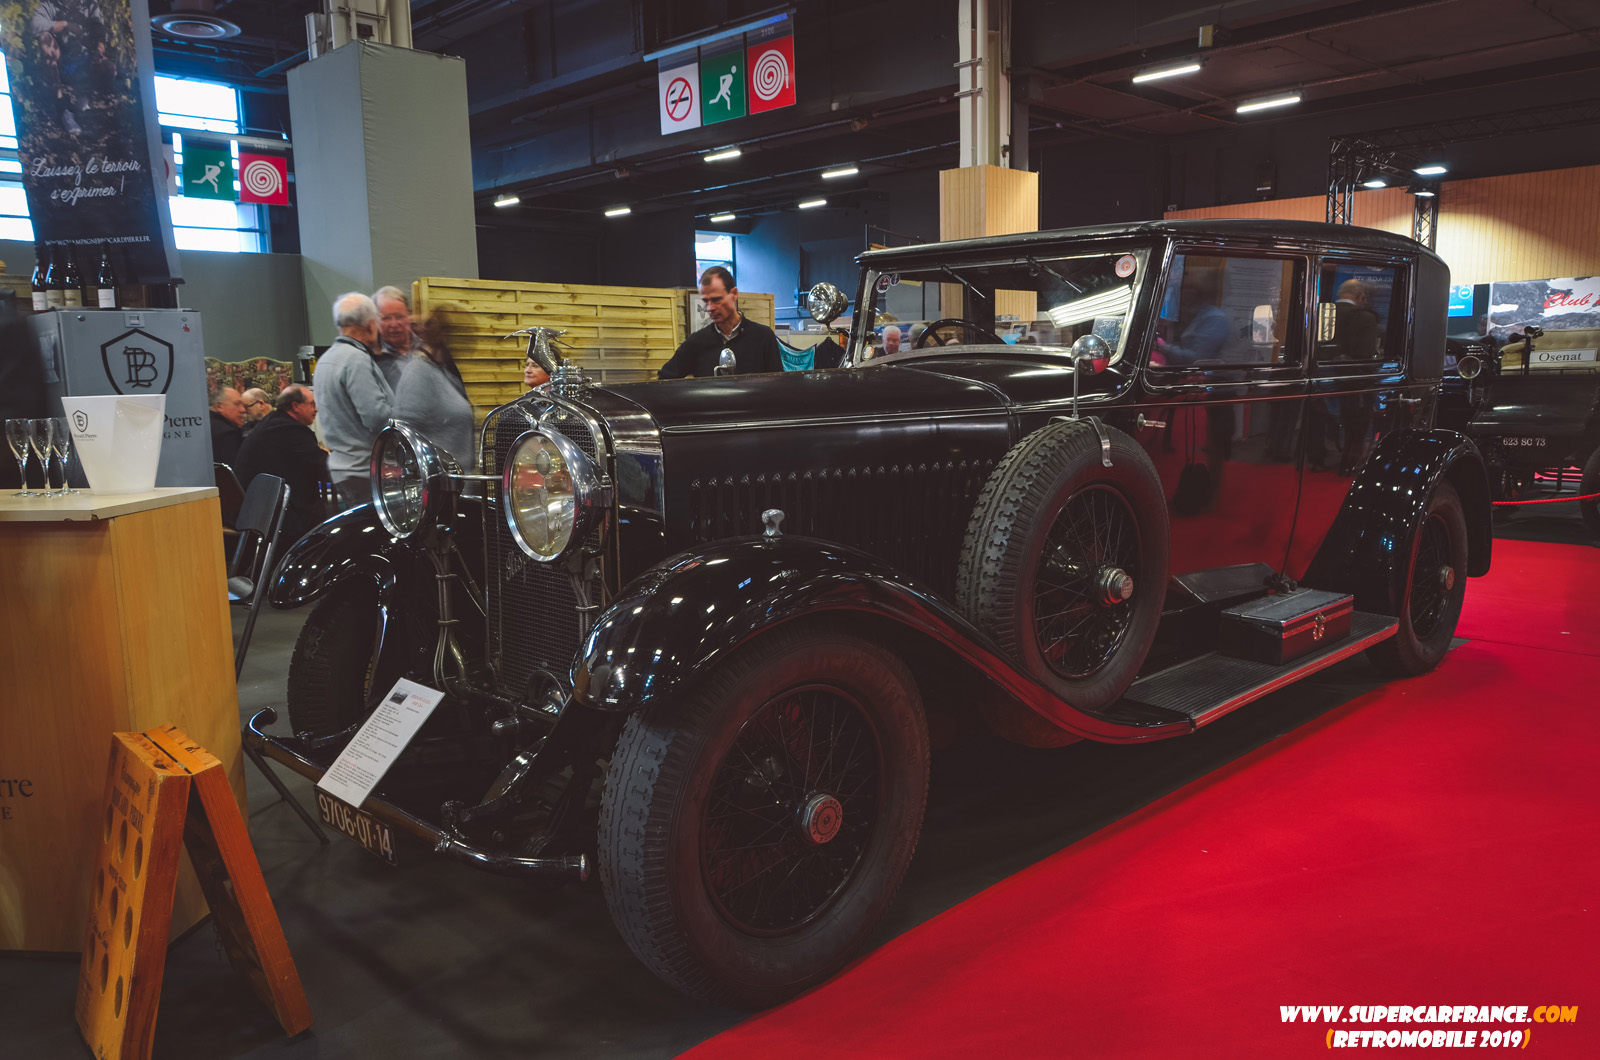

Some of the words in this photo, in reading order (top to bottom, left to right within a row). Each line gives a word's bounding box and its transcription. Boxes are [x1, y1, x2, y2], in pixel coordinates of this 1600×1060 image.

[30, 157, 83, 186] Laissez
[85, 156, 99, 174] le
[101, 155, 141, 173] terroir
[1543, 292, 1594, 309] Club
[1538, 352, 1582, 362] Osenat
[1502, 437, 1519, 446] 623
[1520, 437, 1533, 446] SC
[1535, 437, 1546, 447] 73
[0, 779, 34, 797] rre
